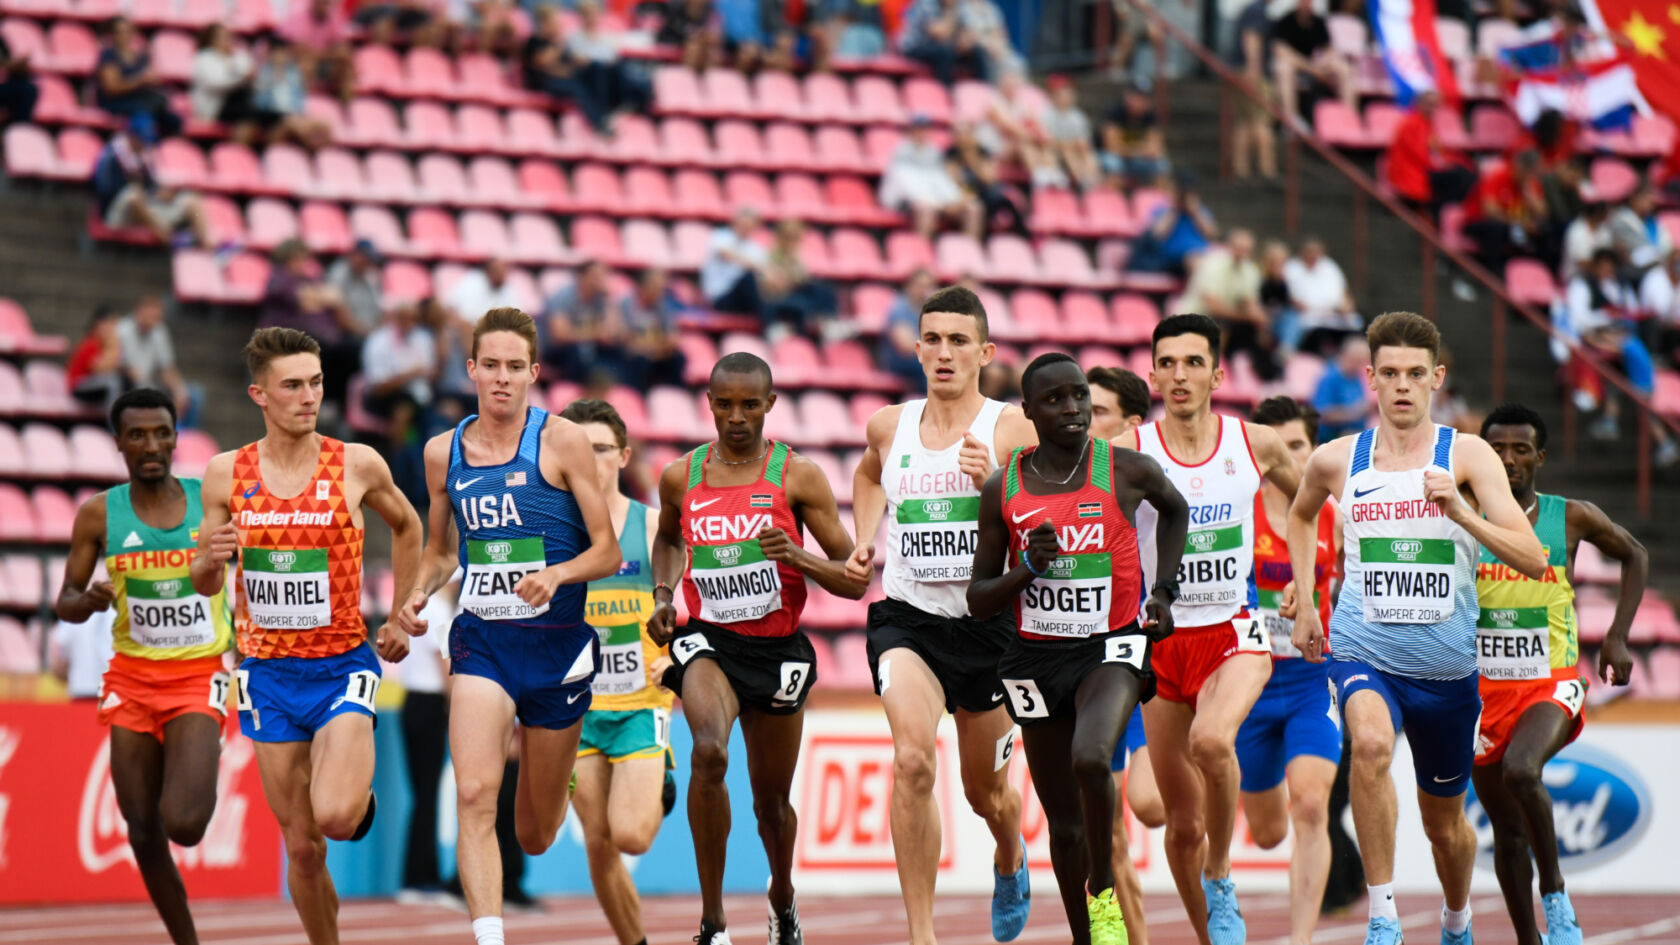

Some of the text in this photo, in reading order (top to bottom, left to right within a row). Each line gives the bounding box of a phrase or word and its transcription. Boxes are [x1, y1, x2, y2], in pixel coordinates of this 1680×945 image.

[898, 471, 976, 495] ALGERIA
[461, 493, 523, 530] USA
[926, 502, 949, 512] KOTI
[1189, 503, 1232, 524] RBIA
[1352, 499, 1445, 523] GREAT BRITAIN
[690, 513, 773, 542] KENYA
[1017, 523, 1105, 552] KNYA
[486, 543, 509, 554] KOTI
[901, 529, 980, 557] CHERRAD
[1192, 535, 1215, 545] KOTI
[1394, 542, 1419, 552] KOTI
[115, 548, 197, 572] ETHIOP
[716, 548, 739, 559] KOTI
[1049, 559, 1075, 569] KOTI
[910, 567, 950, 579] TAMPERE
[1176, 557, 1237, 584] BIBIC
[1260, 560, 1326, 582] NORY
[246, 578, 325, 605] VAN RIEL
[695, 567, 778, 601] MANANGOI
[1364, 571, 1450, 598] HEYWARD
[584, 598, 642, 618] TRALIA
[1025, 583, 1106, 613] SOGET
[1178, 589, 1236, 604] AMPERE 2018
[132, 601, 206, 628] SORSA
[255, 614, 318, 627] TAMPERE 2018
[470, 604, 537, 617] TAMPERE 2018
[712, 608, 749, 621] TAMPERE
[1373, 607, 1440, 621] TAMPERE 2018
[1032, 619, 1075, 634] TAMPERE
[1247, 620, 1263, 645] 4
[1116, 642, 1133, 659] 3
[1475, 634, 1545, 658] TEFERA
[598, 650, 638, 675] VIES
[1518, 666, 1539, 677] 2018
[358, 674, 376, 704] 11
[785, 669, 801, 696] 8
[1015, 684, 1035, 712] 3
[1002, 734, 1014, 760] 6
[817, 761, 894, 846] DE
